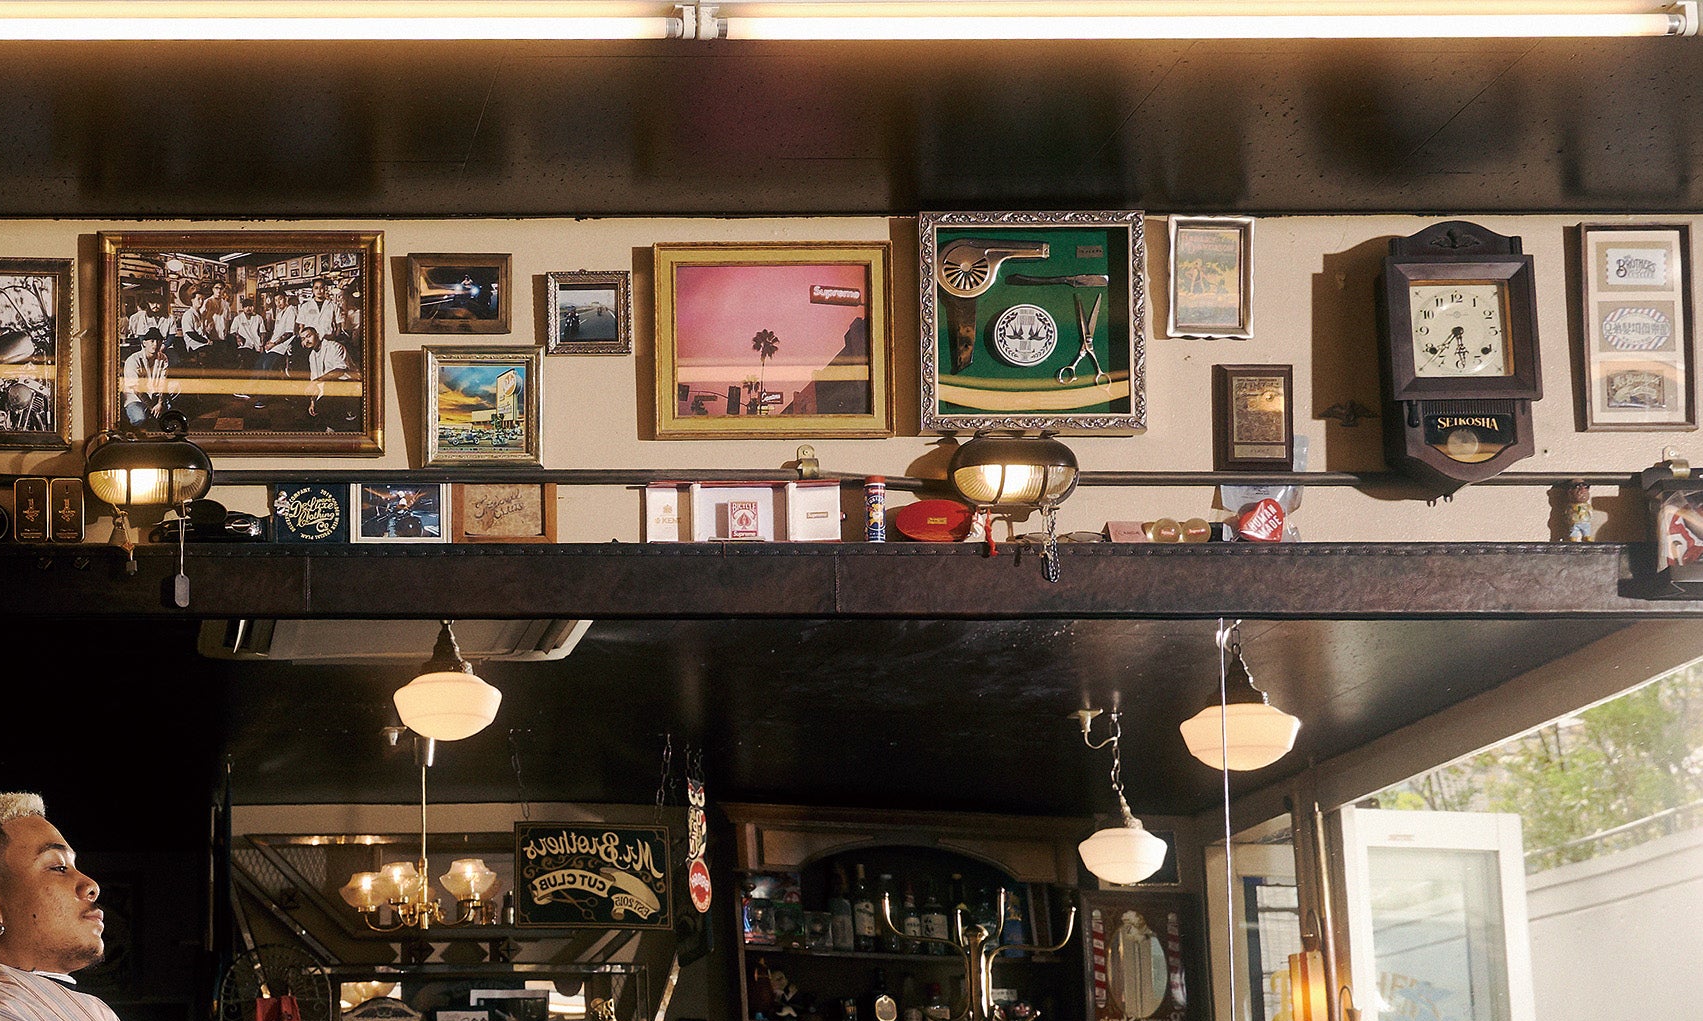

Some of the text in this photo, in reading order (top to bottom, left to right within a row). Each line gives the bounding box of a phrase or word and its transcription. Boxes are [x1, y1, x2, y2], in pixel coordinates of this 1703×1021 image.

[813, 285, 861, 299] Supreme
[1437, 417, 1499, 432] SEIKOSHA
[733, 503, 756, 511] BICYCLE
[1248, 504, 1277, 531] HUMAN
[1259, 514, 1283, 538] MADE
